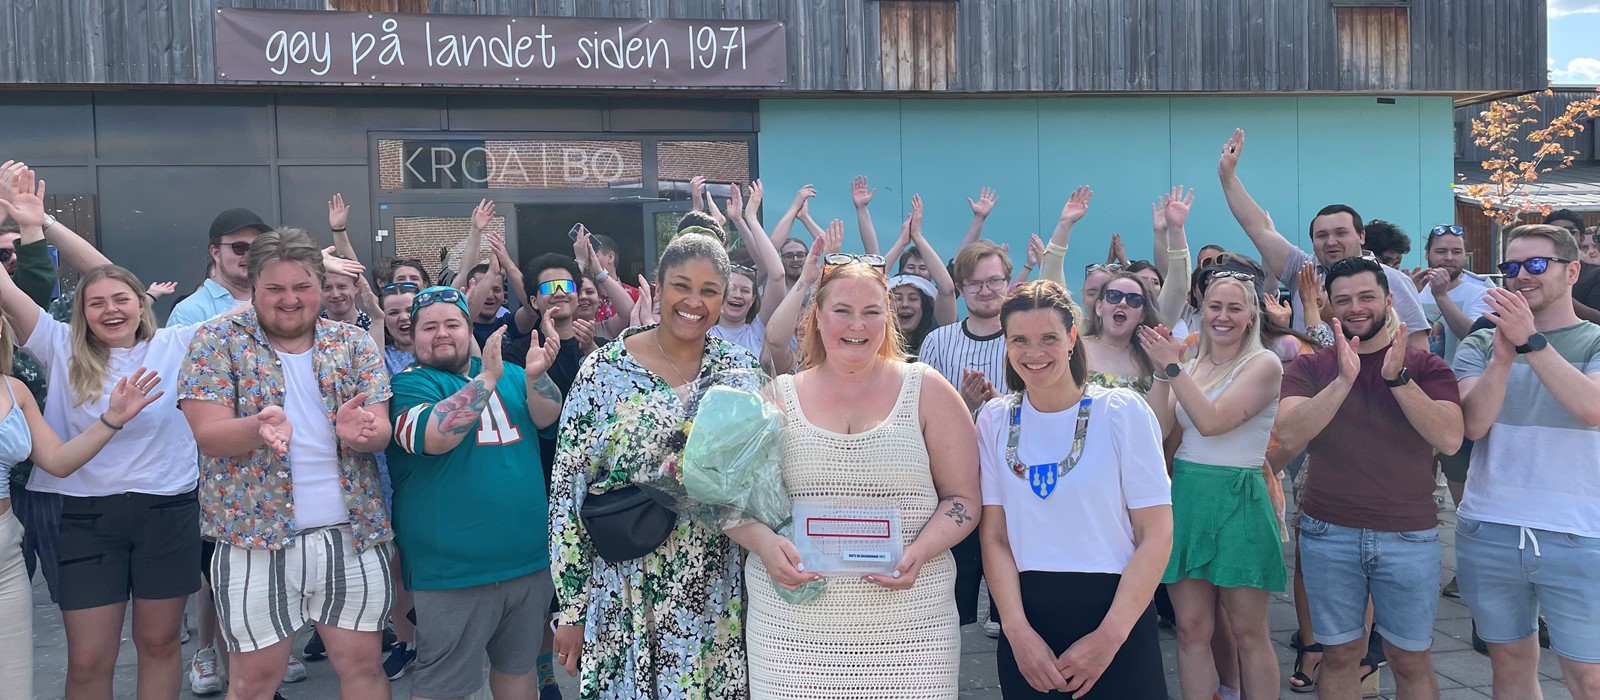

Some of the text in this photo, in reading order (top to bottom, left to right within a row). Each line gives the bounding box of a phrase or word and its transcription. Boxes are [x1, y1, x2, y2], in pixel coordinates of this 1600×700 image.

[265, 18, 747, 76] gøy på landet siden 1971
[399, 146, 530, 183] KROA
[562, 146, 625, 182] BØ
